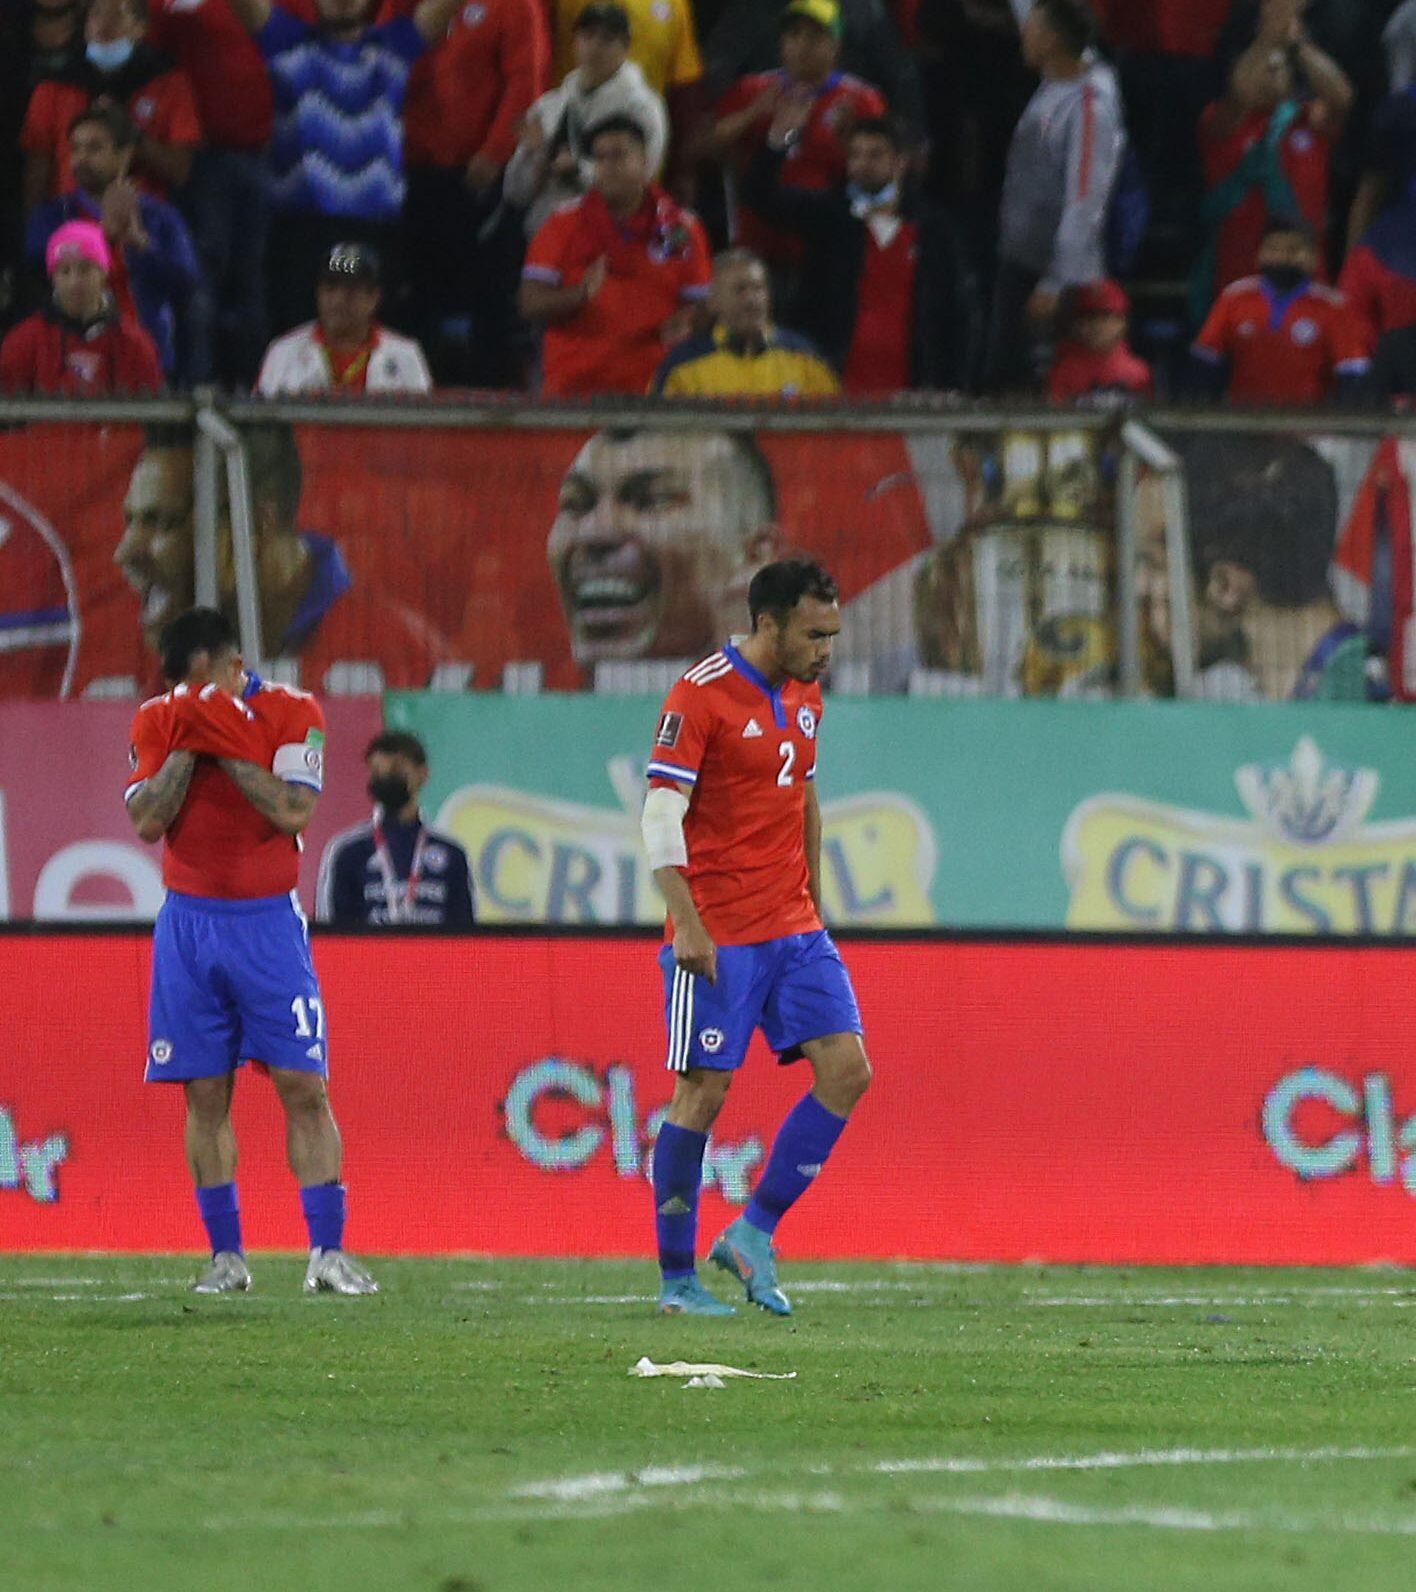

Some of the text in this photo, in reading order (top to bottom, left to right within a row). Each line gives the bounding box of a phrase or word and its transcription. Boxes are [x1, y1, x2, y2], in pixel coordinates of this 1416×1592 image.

[777, 741, 797, 787] 2
[478, 825, 895, 924] CRIL
[291, 994, 324, 1038] 17
[504, 1057, 764, 1203] Clr
